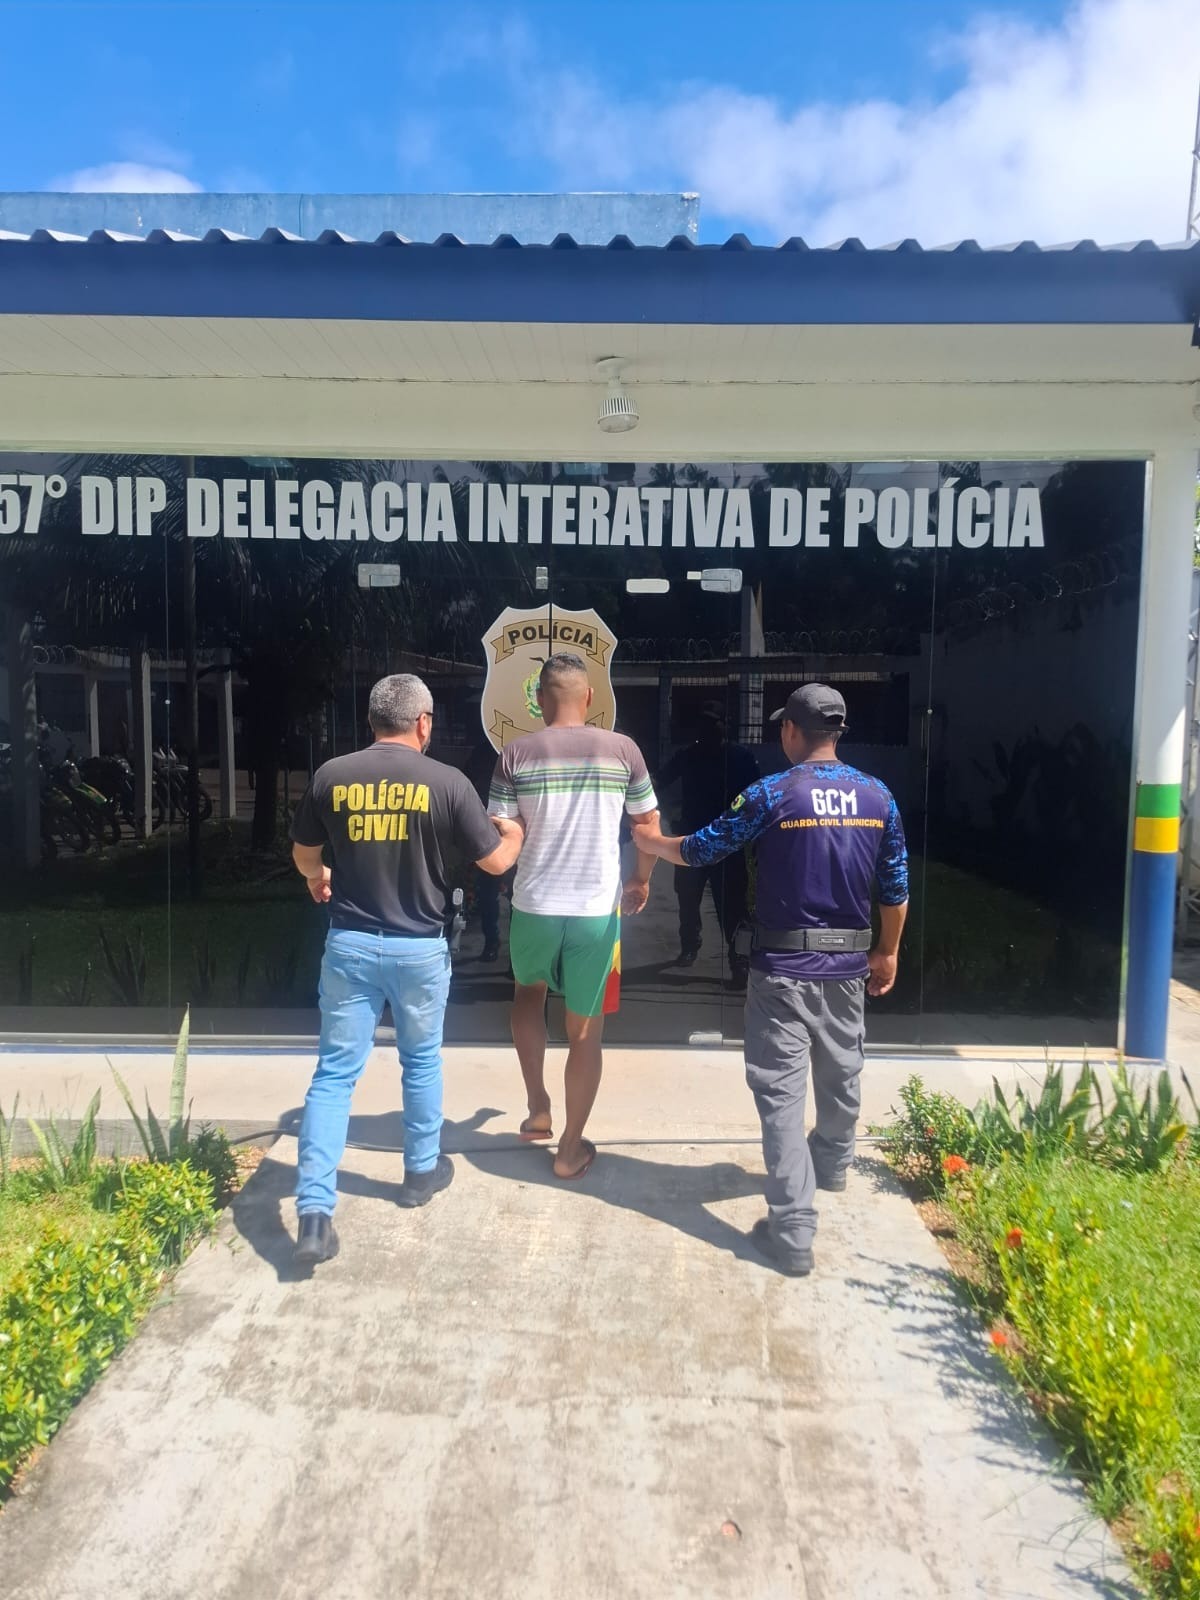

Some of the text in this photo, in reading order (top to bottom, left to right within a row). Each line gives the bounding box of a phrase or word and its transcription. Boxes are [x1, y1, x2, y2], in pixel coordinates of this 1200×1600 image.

[81, 476, 167, 537] DIP
[187, 478, 458, 543] DELEGACIA
[469, 483, 755, 548] INTERATIVA
[769, 487, 830, 548] DE
[843, 477, 1045, 548] POLÍCIA
[508, 622, 594, 648] POLÍCIA
[333, 778, 430, 812] POLÍCIA
[811, 788, 858, 816] GCM
[348, 813, 408, 841] CIVIL
[780, 818, 818, 829] GUARDA
[819, 818, 841, 827] CIVIL
